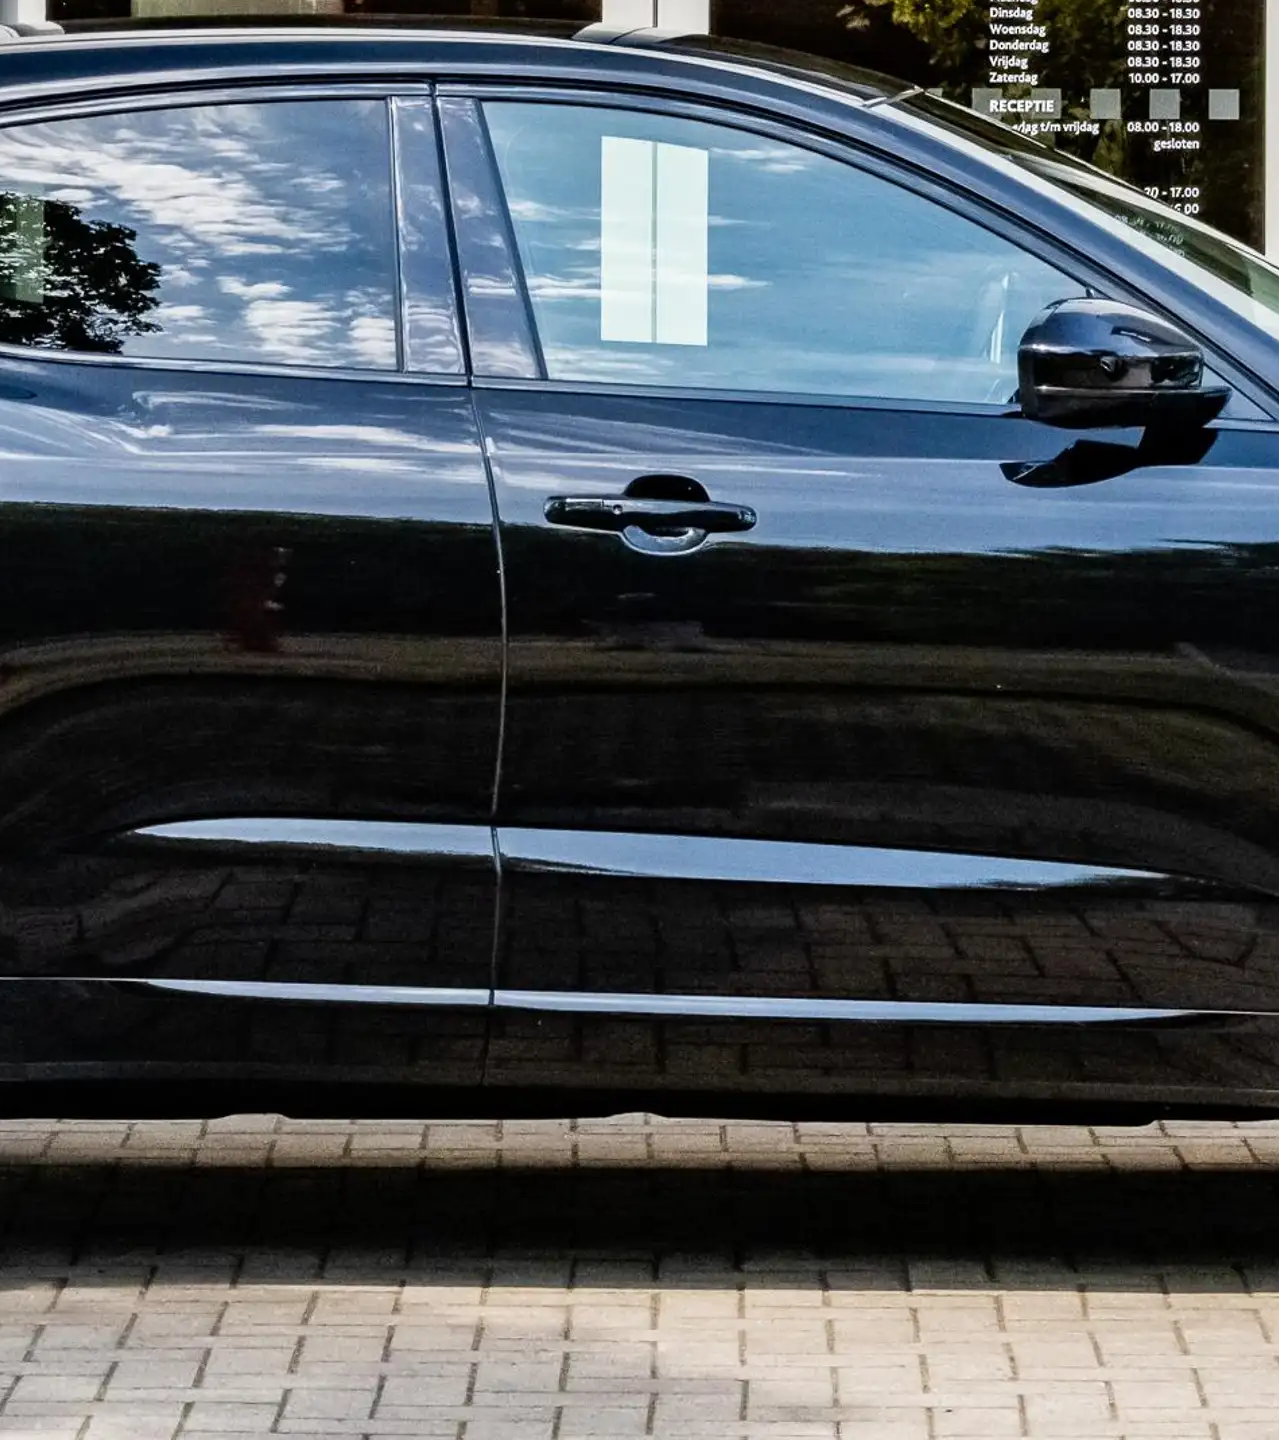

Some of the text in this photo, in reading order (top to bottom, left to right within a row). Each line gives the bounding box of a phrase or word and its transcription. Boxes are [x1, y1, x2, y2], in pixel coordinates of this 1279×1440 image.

[989, 7, 1033, 20] Dinsdag
[1127, 8, 1160, 19] 08.30
[1169, 8, 1201, 19] 18.30
[989, 24, 1046, 37] Woensdag
[1127, 25, 1160, 36] 08.30
[1169, 25, 1201, 36] 18.30
[989, 40, 1049, 53] Donderdag
[1127, 41, 1160, 52] 08.30
[1169, 41, 1201, 52] 18.30
[989, 56, 1029, 69] Vrijdag
[1127, 57, 1160, 68] 08.30
[1169, 57, 1201, 68] 18.30
[989, 72, 1038, 85] Zaterdag
[1127, 73, 1160, 84] 10.00
[1169, 73, 1201, 84] 17.00
[989, 99, 1054, 113] RECEPTIE
[1040, 121, 1061, 132] t/m
[1063, 121, 1100, 136] vrijdag
[1126, 122, 1160, 133] 08.00
[1168, 122, 1200, 133] 18.00
[1153, 137, 1200, 152] gesloten
[1169, 187, 1200, 198] 17.00
